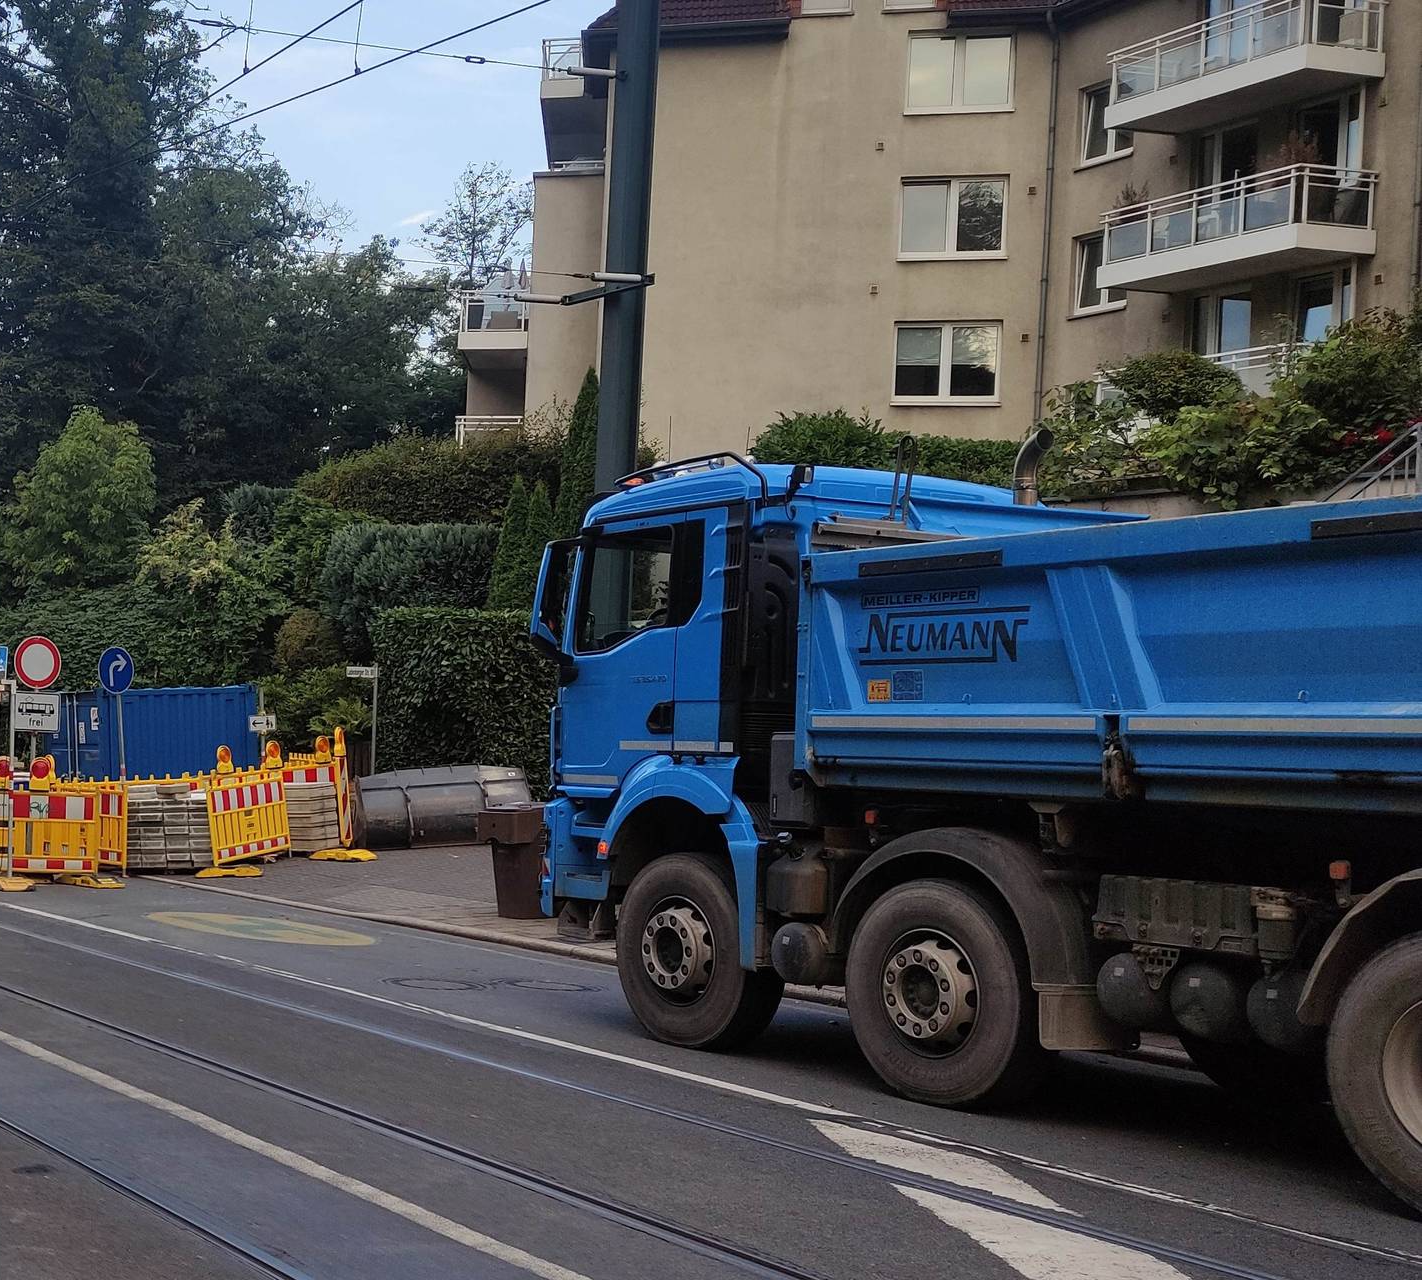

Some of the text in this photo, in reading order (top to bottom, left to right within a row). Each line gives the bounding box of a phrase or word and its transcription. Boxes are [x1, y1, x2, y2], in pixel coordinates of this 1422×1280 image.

[864, 589, 977, 607] MEILLER-KIPPER
[858, 608, 1030, 664] NEUMANN
[29, 717, 44, 727] frei
